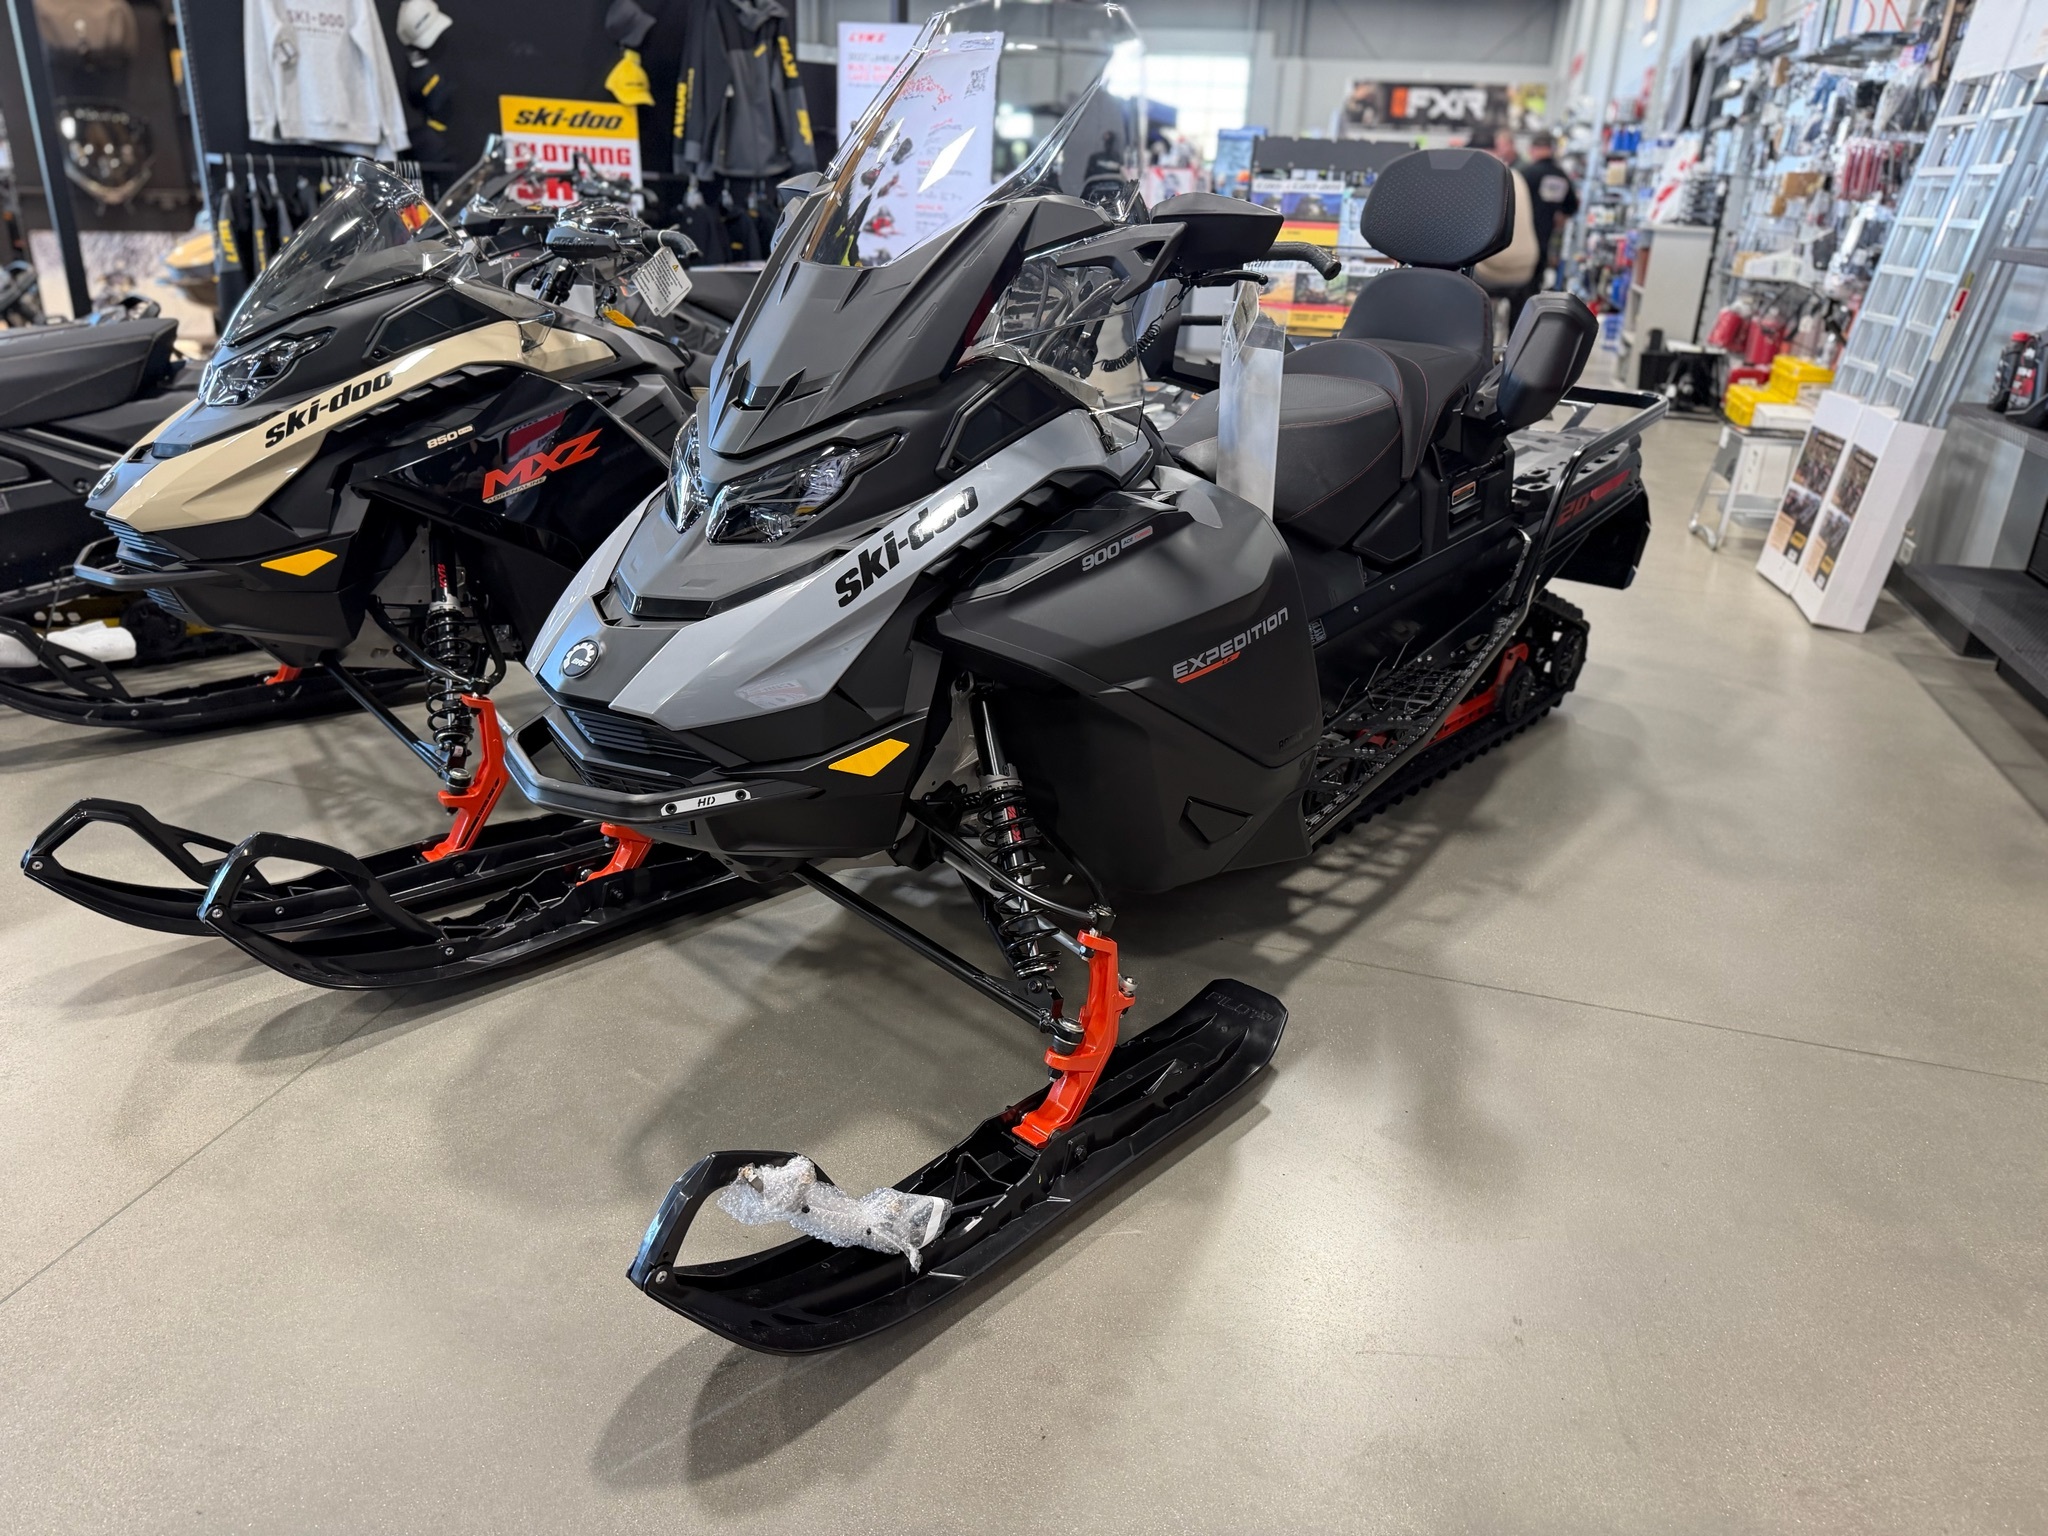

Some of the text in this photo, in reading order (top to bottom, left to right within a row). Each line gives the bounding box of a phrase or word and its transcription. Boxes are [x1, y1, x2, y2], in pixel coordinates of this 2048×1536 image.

[514, 107, 624, 131] ski-doo
[514, 141, 632, 167] CLOTHING
[265, 371, 394, 449] ski-doo
[426, 430, 459, 450] 850
[482, 428, 603, 500] MXZ
[1081, 541, 1121, 572] 900
[1172, 606, 1289, 679] EXPEDITION
[571, 657, 589, 667] BRP
[697, 796, 716, 807] HD
